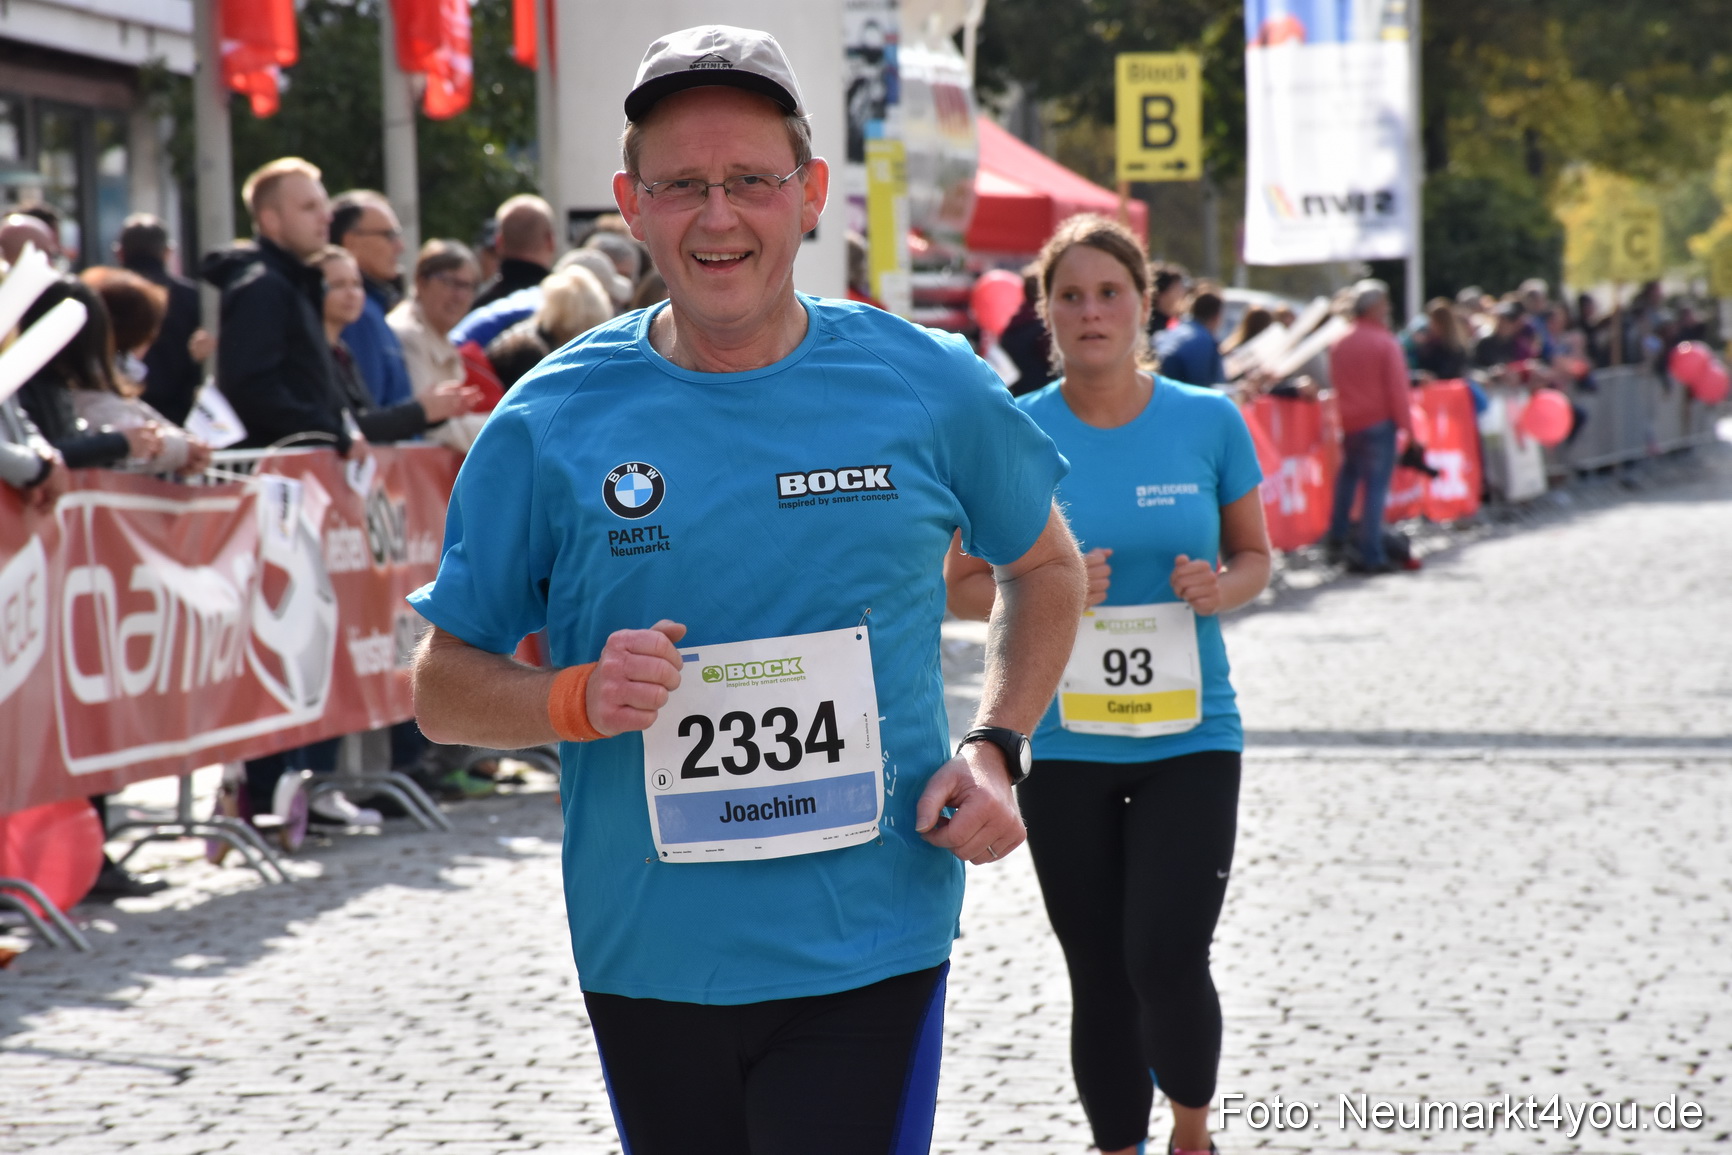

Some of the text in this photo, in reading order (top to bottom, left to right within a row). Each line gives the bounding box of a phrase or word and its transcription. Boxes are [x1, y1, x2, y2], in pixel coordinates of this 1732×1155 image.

[1139, 95, 1179, 151] B
[607, 463, 659, 484] BMW
[777, 466, 894, 498] BOCK
[778, 492, 899, 510] inspired by smart concepts
[1137, 495, 1176, 507] Carina
[608, 525, 669, 545] PARTL
[610, 540, 671, 557] Neumarkt
[726, 657, 804, 680] BOCK
[1102, 647, 1154, 687] 93
[780, 675, 806, 683] concepts
[1107, 701, 1152, 715] Carina
[677, 700, 845, 780] 2334
[658, 775, 666, 786] D
[719, 795, 817, 823] Joachim
